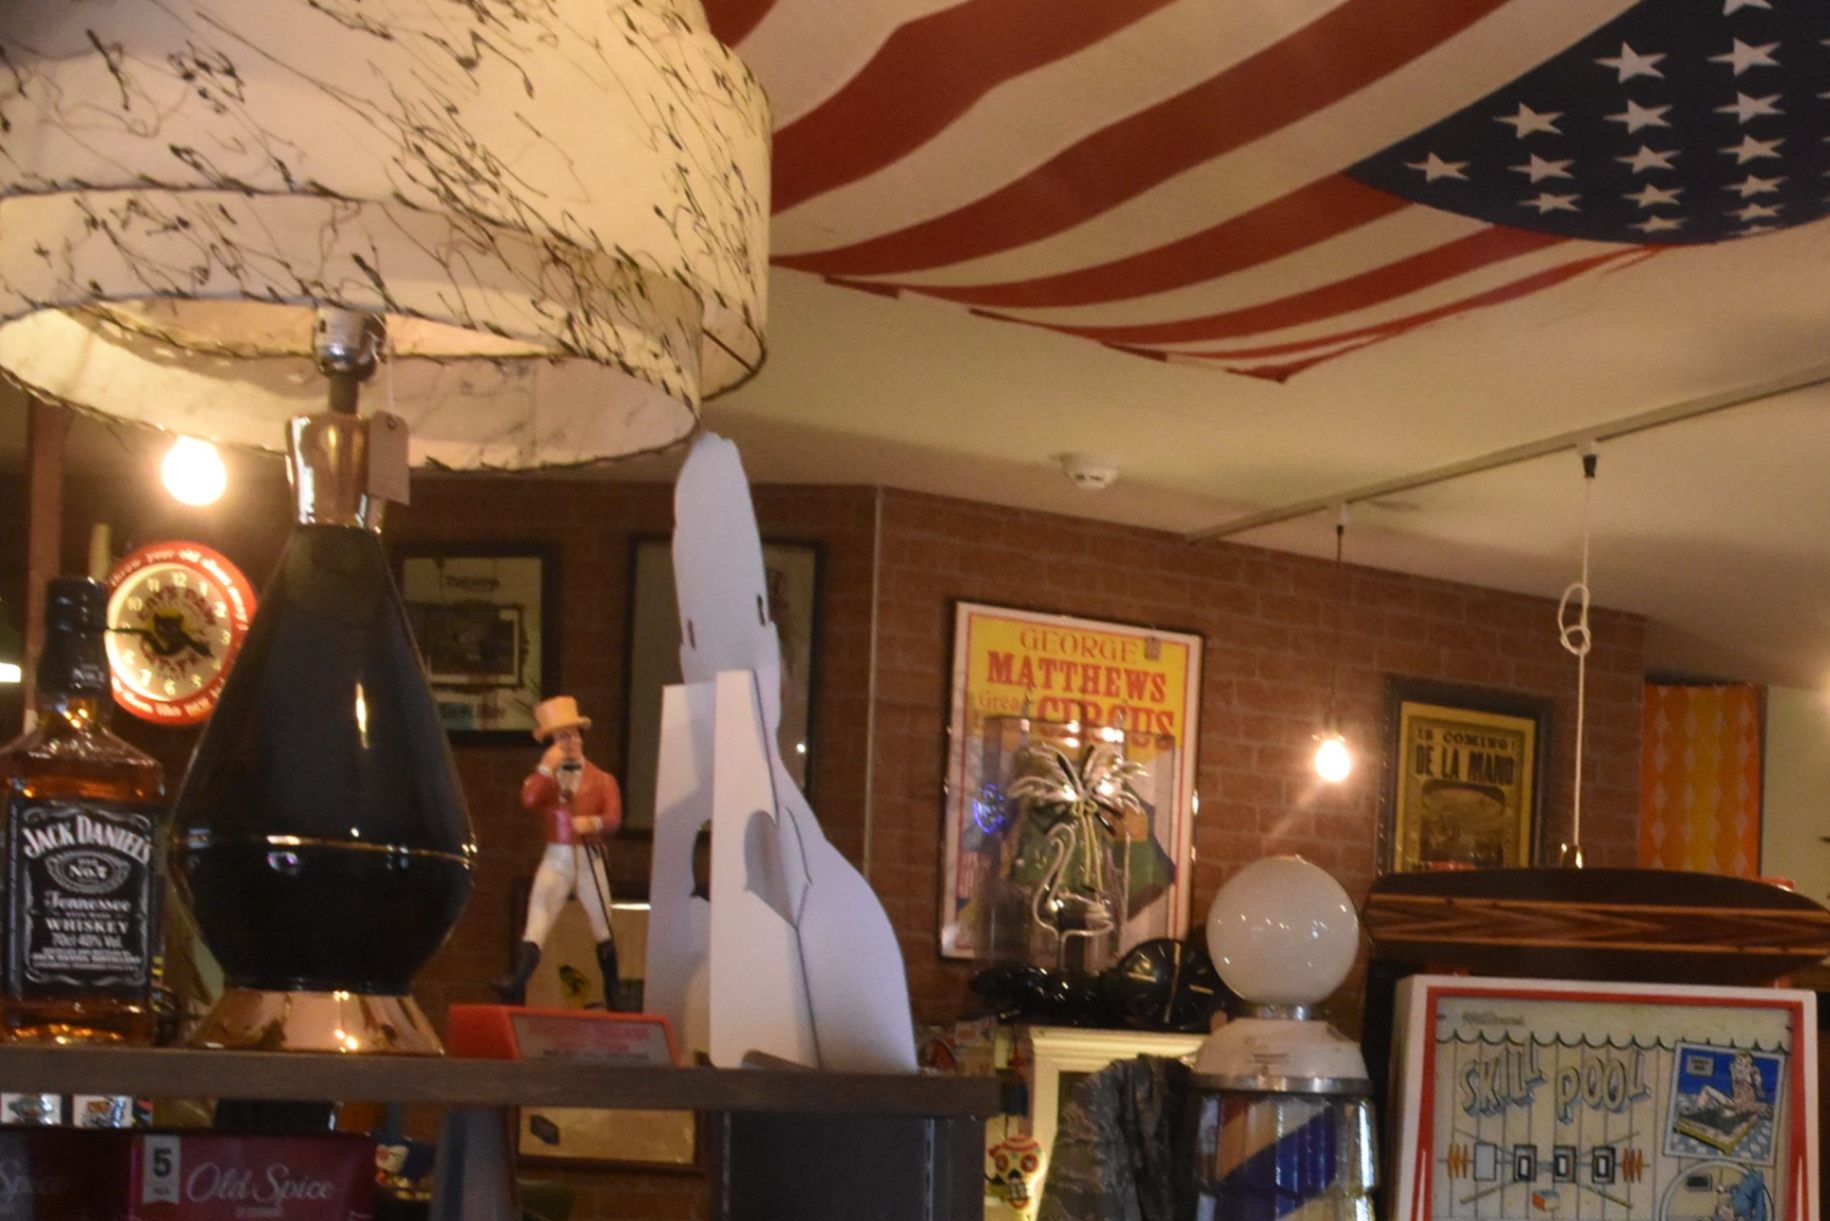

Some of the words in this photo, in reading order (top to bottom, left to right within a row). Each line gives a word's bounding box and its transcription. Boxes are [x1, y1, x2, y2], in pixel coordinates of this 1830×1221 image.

[1020, 628, 1138, 665] GEORGE
[986, 651, 1168, 704] MATTHEWS
[22, 820, 76, 859] JACK
[45, 918, 129, 935] WHISKEY
[1458, 1040, 1547, 1118] SKILL
[1555, 1047, 1652, 1125] POOL
[152, 1147, 173, 1178] 5
[187, 1162, 252, 1203] Old
[252, 1163, 336, 1209] Spice
